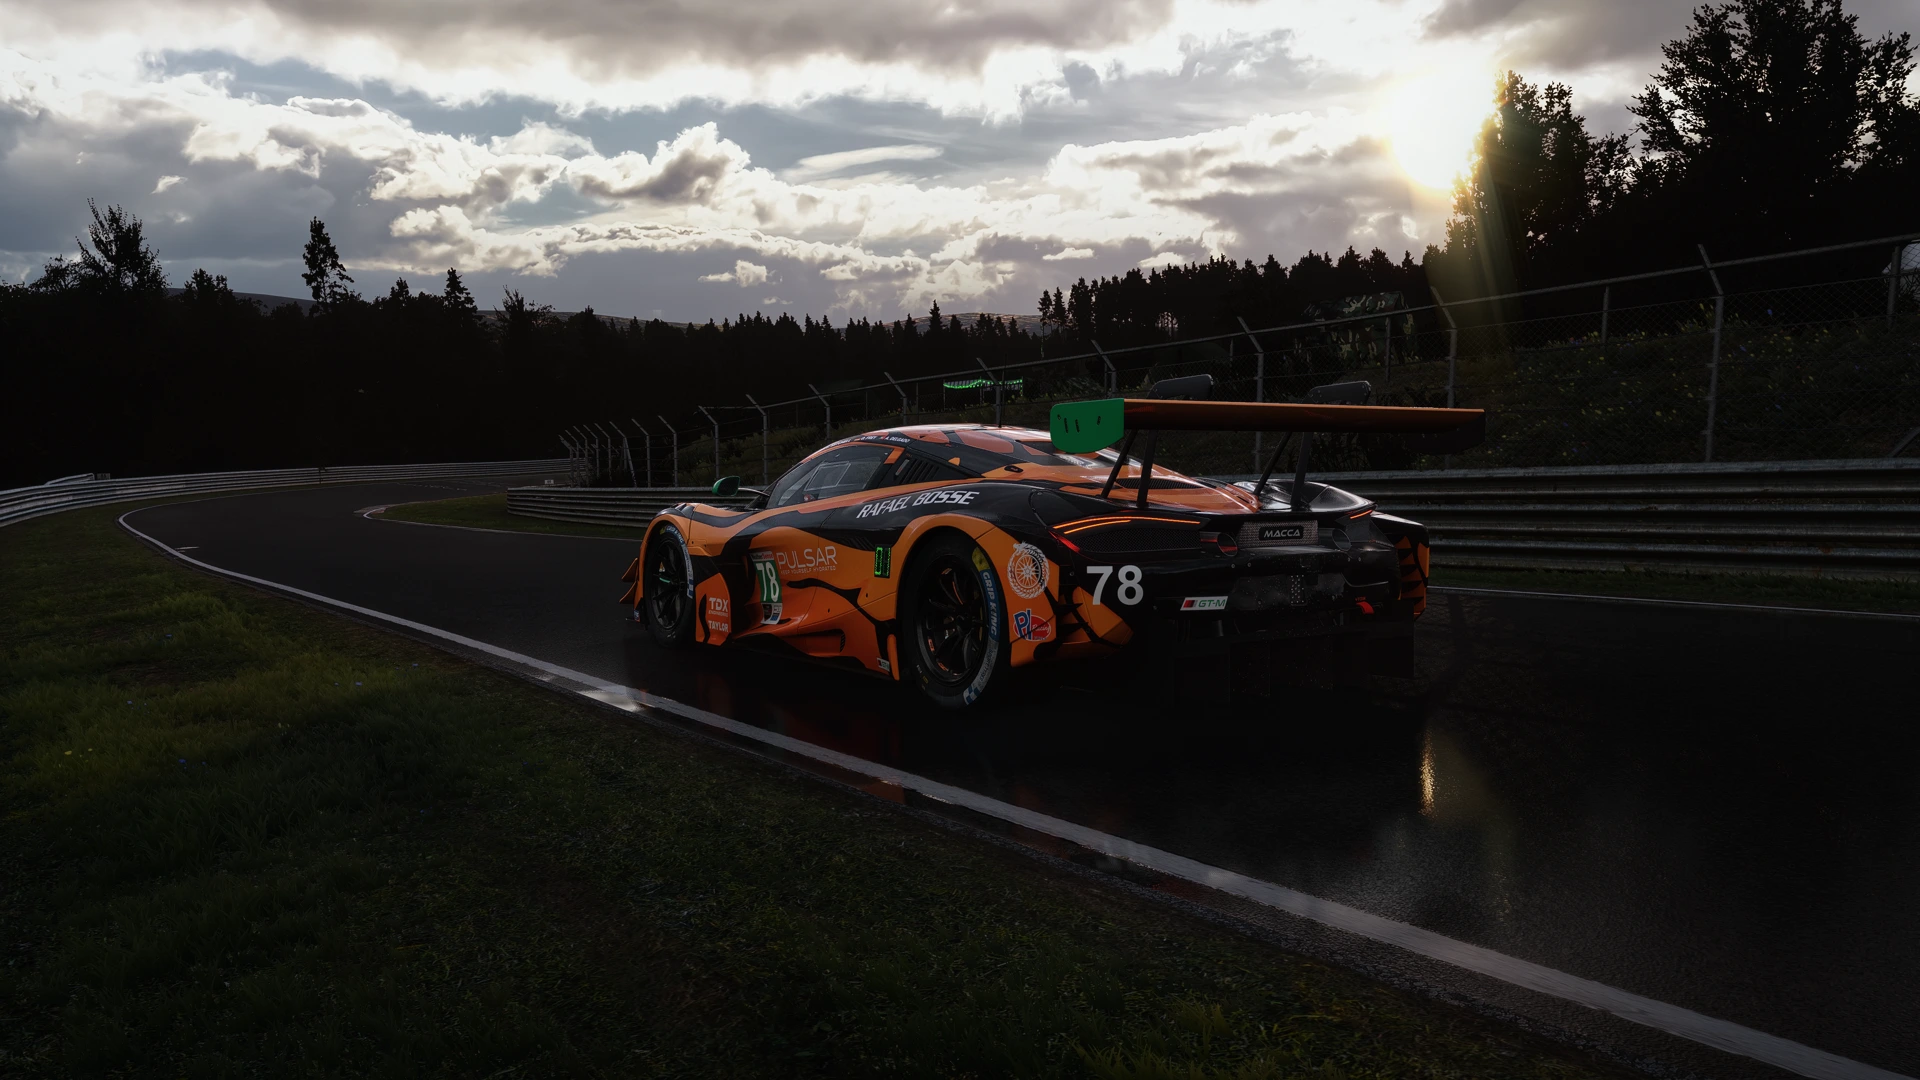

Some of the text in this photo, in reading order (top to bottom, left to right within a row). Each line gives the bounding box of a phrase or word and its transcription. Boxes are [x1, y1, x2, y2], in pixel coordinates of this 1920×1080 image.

[856, 490, 980, 519] RAFAEL BOSSE
[1263, 528, 1301, 538] MACCA
[776, 545, 838, 569] PULSAR
[755, 561, 780, 602] 78
[1086, 564, 1144, 606] 78
[708, 597, 729, 612] TDX
[982, 571, 997, 635] GRIP KING
[1198, 598, 1227, 608] GT-M
[707, 619, 729, 633] TAYLOR
